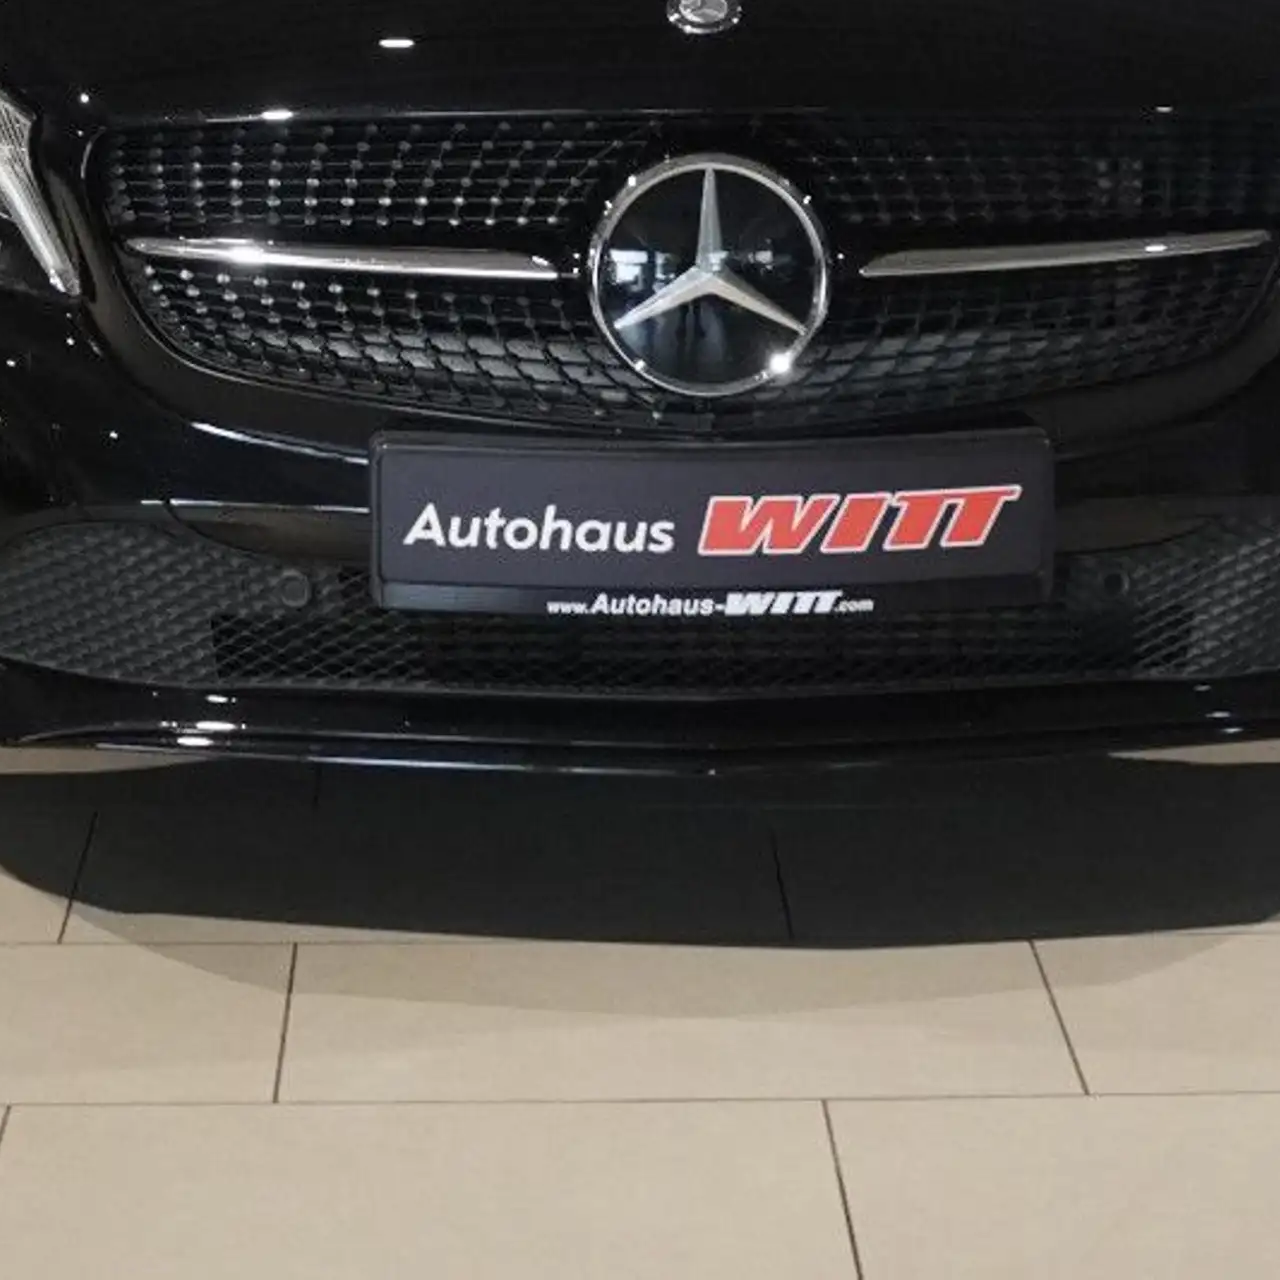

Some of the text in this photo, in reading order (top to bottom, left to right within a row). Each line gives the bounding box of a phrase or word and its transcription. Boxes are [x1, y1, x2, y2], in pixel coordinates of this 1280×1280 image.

[403, 485, 1021, 556] Autohaus WITT
[547, 590, 874, 616] www.Autohaus-WITT.com
